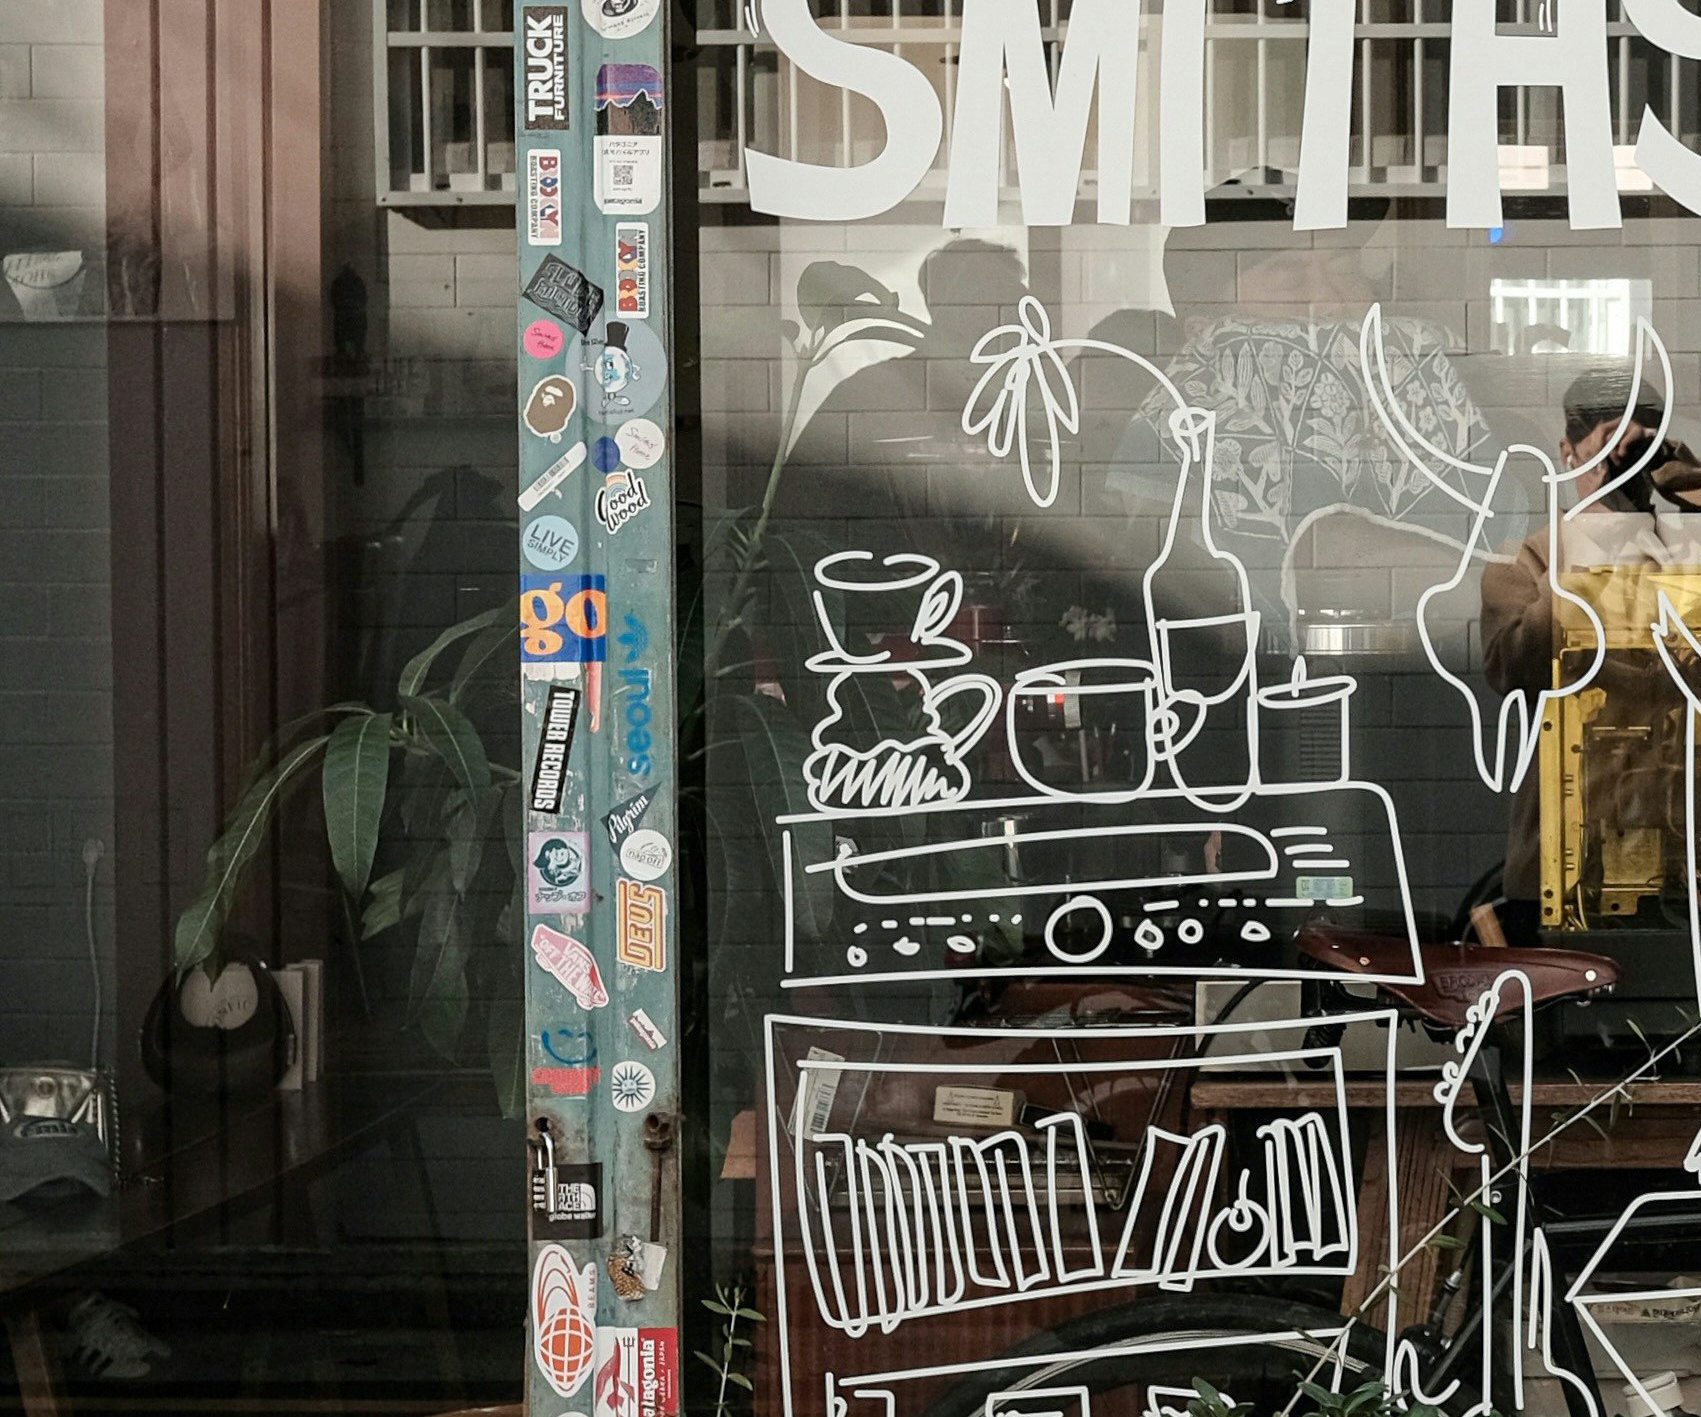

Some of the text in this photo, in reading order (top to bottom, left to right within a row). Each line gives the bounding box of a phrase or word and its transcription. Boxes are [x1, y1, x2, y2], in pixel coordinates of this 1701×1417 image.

[526, 14, 554, 122] TRUCK
[552, 14, 566, 121] FURNITURE
[527, 538, 567, 564] SIMPLY
[530, 523, 575, 557] LIVE
[533, 690, 576, 810] TOWER RECORDS
[607, 795, 649, 844] Pilgrim
[557, 1202, 582, 1211] ACE
[558, 1184, 581, 1193] THE
[548, 1211, 573, 1222] globe
[587, 1268, 596, 1310] BEAMS
